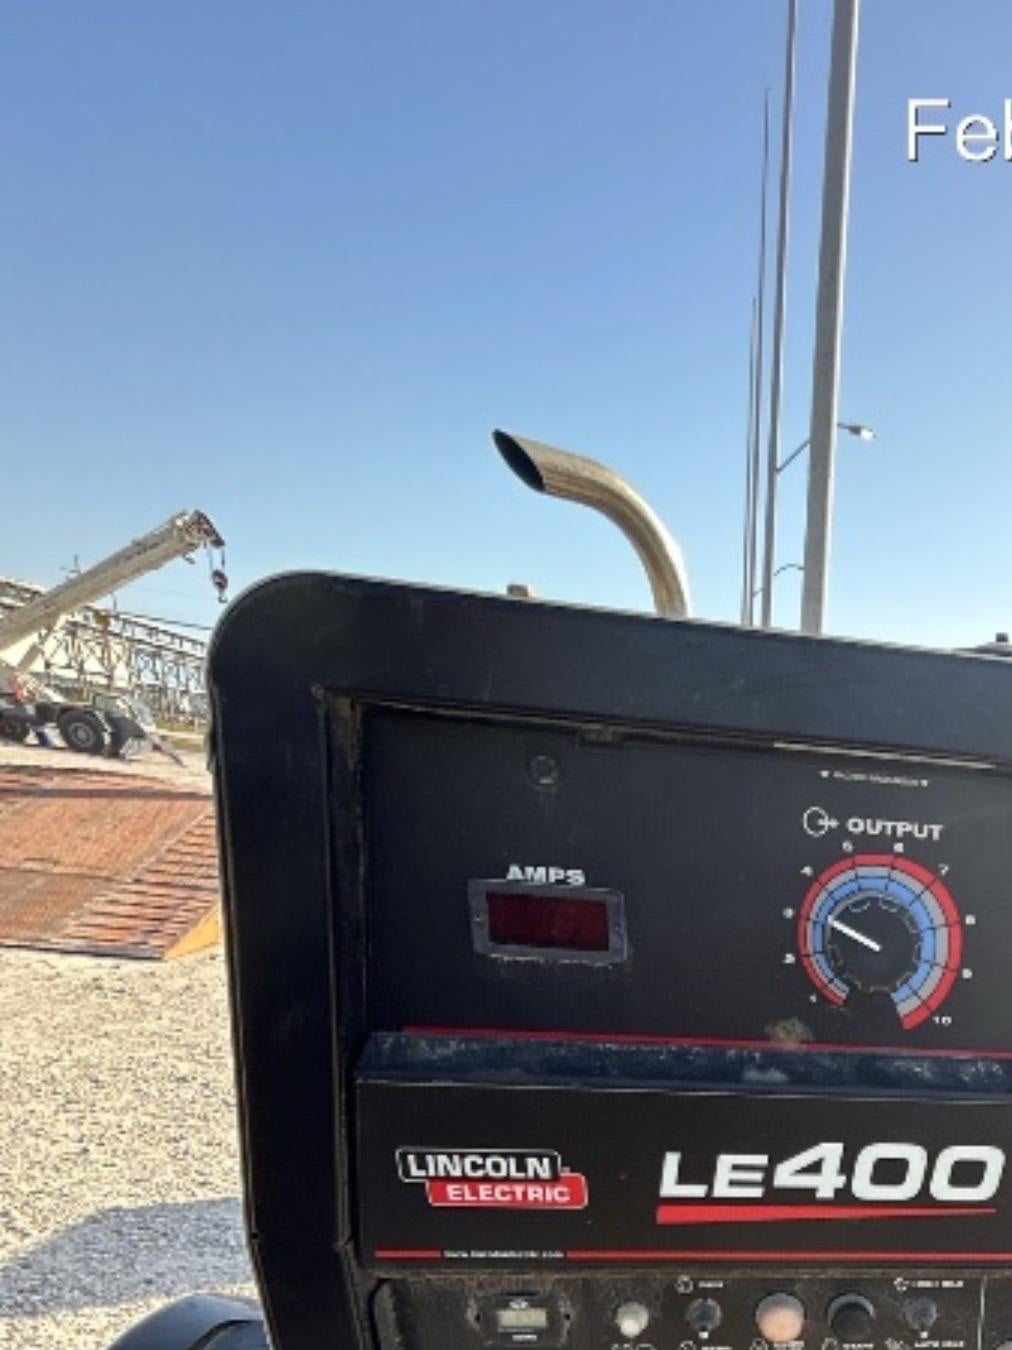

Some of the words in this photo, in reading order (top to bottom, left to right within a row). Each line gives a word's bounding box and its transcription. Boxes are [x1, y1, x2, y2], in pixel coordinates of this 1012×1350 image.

[847, 817, 943, 840] OUTPUT
[506, 864, 585, 887] AMPS
[406, 1154, 553, 1179] LINCOLN
[659, 1142, 1006, 1201] LE400
[446, 1183, 571, 1203] ELECTRIC
